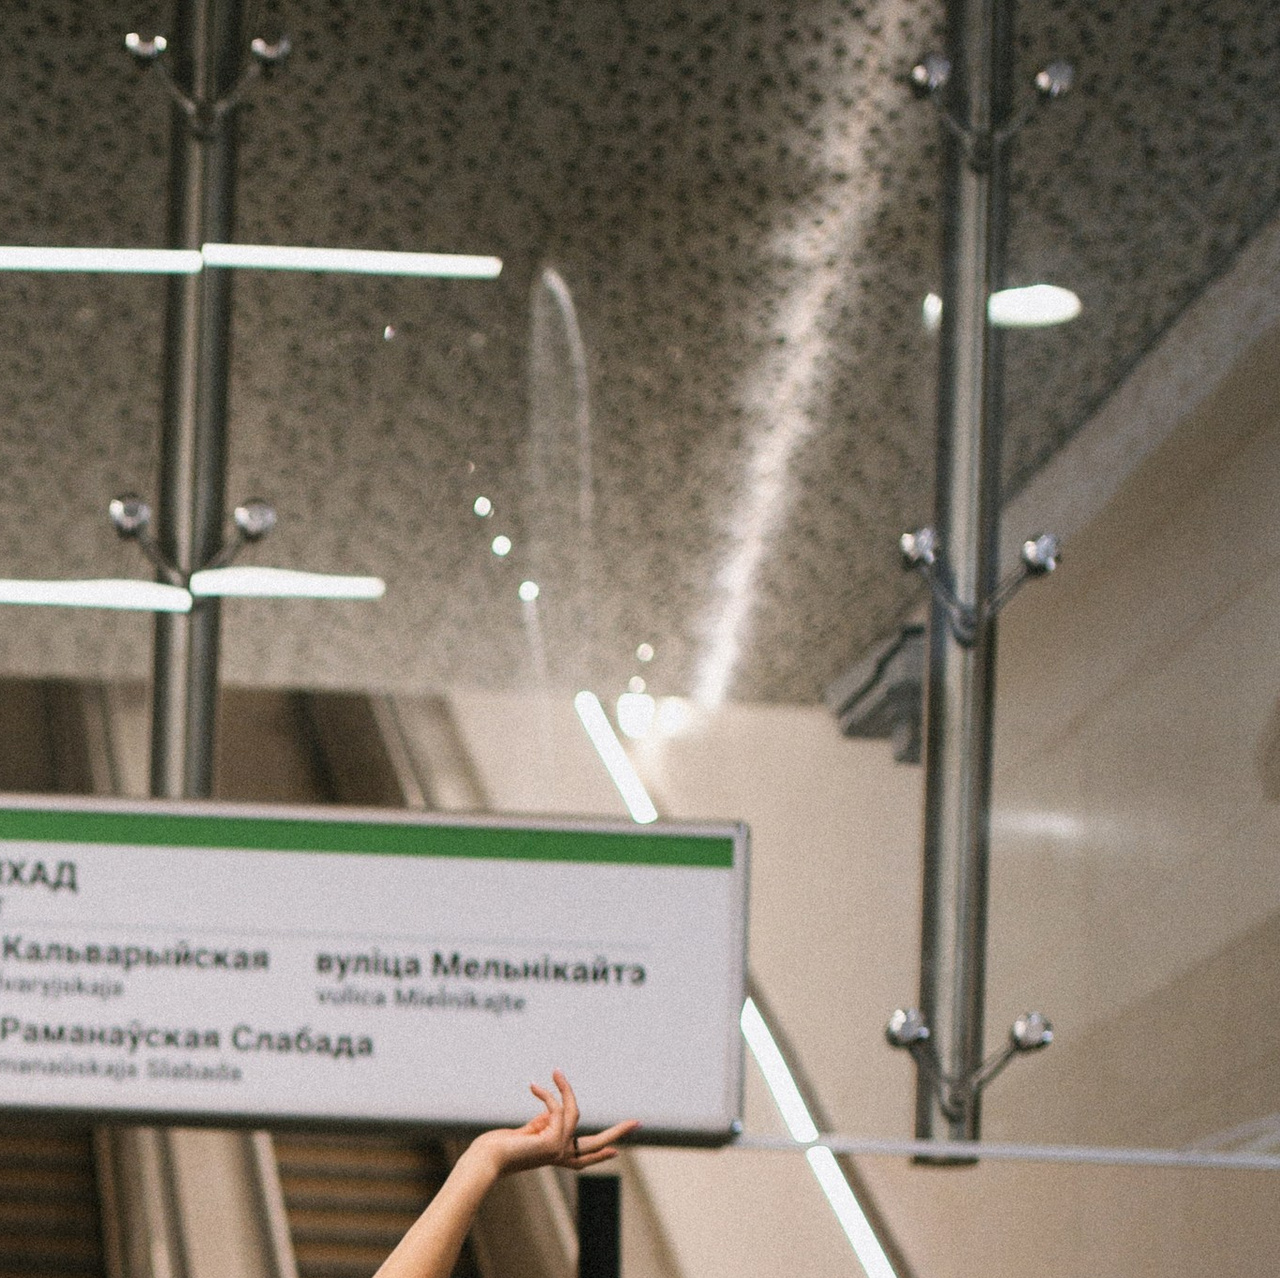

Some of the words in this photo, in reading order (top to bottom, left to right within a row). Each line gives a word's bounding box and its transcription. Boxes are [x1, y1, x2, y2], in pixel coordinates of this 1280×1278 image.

[1, 935, 270, 972] Кальварыйская
[316, 949, 422, 980] вуліца
[431, 951, 647, 986] Мельнікайтэ
[230, 1024, 375, 1059] Слабада
